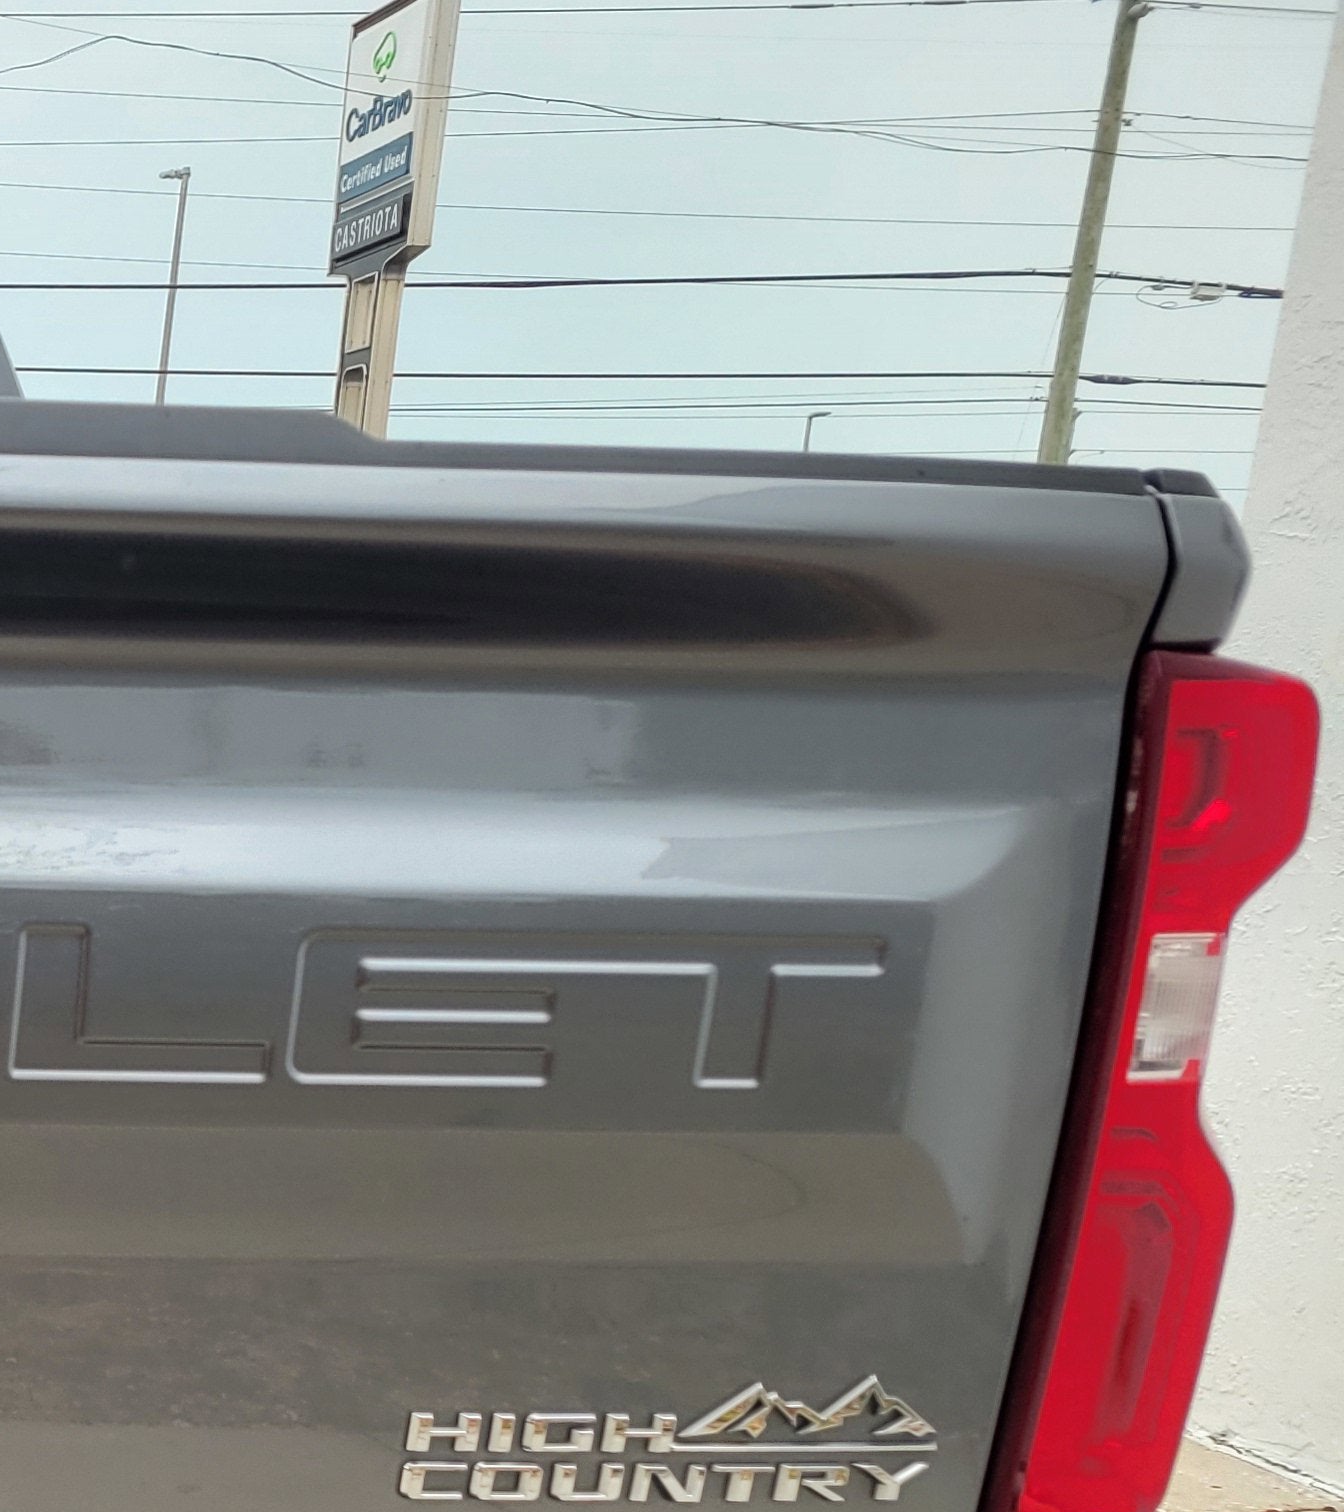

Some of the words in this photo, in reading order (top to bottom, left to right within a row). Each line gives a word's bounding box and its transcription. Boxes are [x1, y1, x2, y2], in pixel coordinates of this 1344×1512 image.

[346, 89, 412, 142] CarBravo
[341, 163, 381, 193] Certified
[384, 145, 407, 173] Used
[334, 203, 399, 252] CASTRIOTA
[404, 1412, 678, 1453] HIGH
[398, 1461, 930, 1502] COUNTRY
